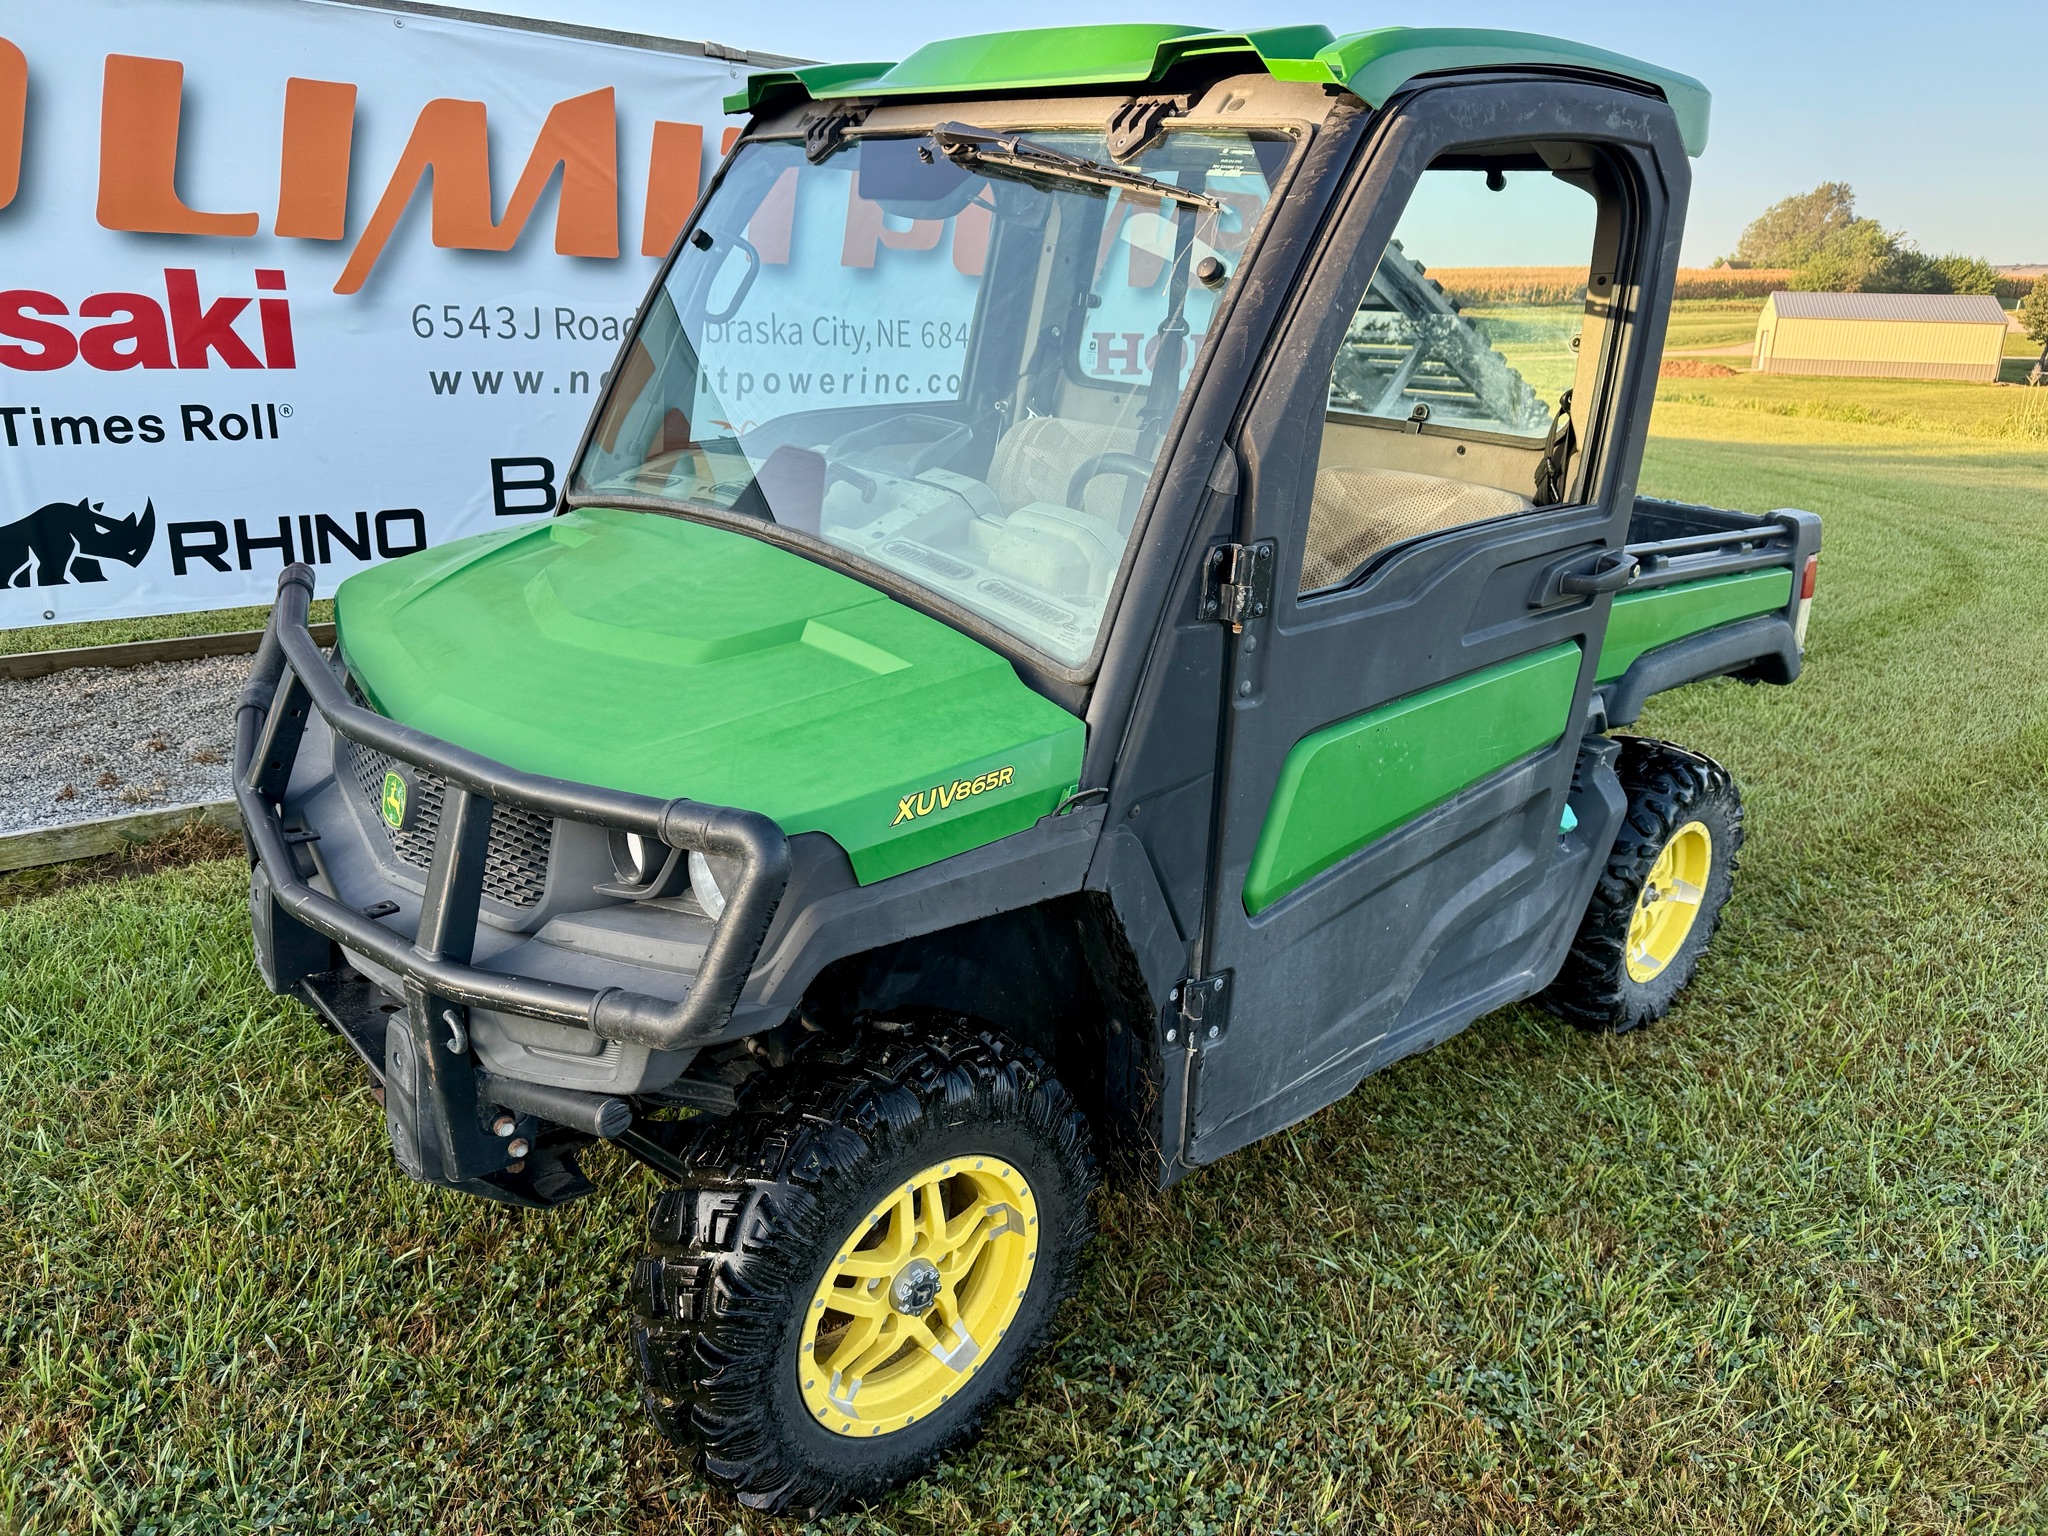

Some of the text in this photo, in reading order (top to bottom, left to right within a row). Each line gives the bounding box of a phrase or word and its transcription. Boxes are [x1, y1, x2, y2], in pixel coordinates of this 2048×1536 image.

[0, 267, 297, 371] saki
[921, 320, 972, 350] 684
[0, 406, 166, 447] Times
[167, 508, 428, 577] RHINO
[888, 765, 1015, 828] XUV865R
